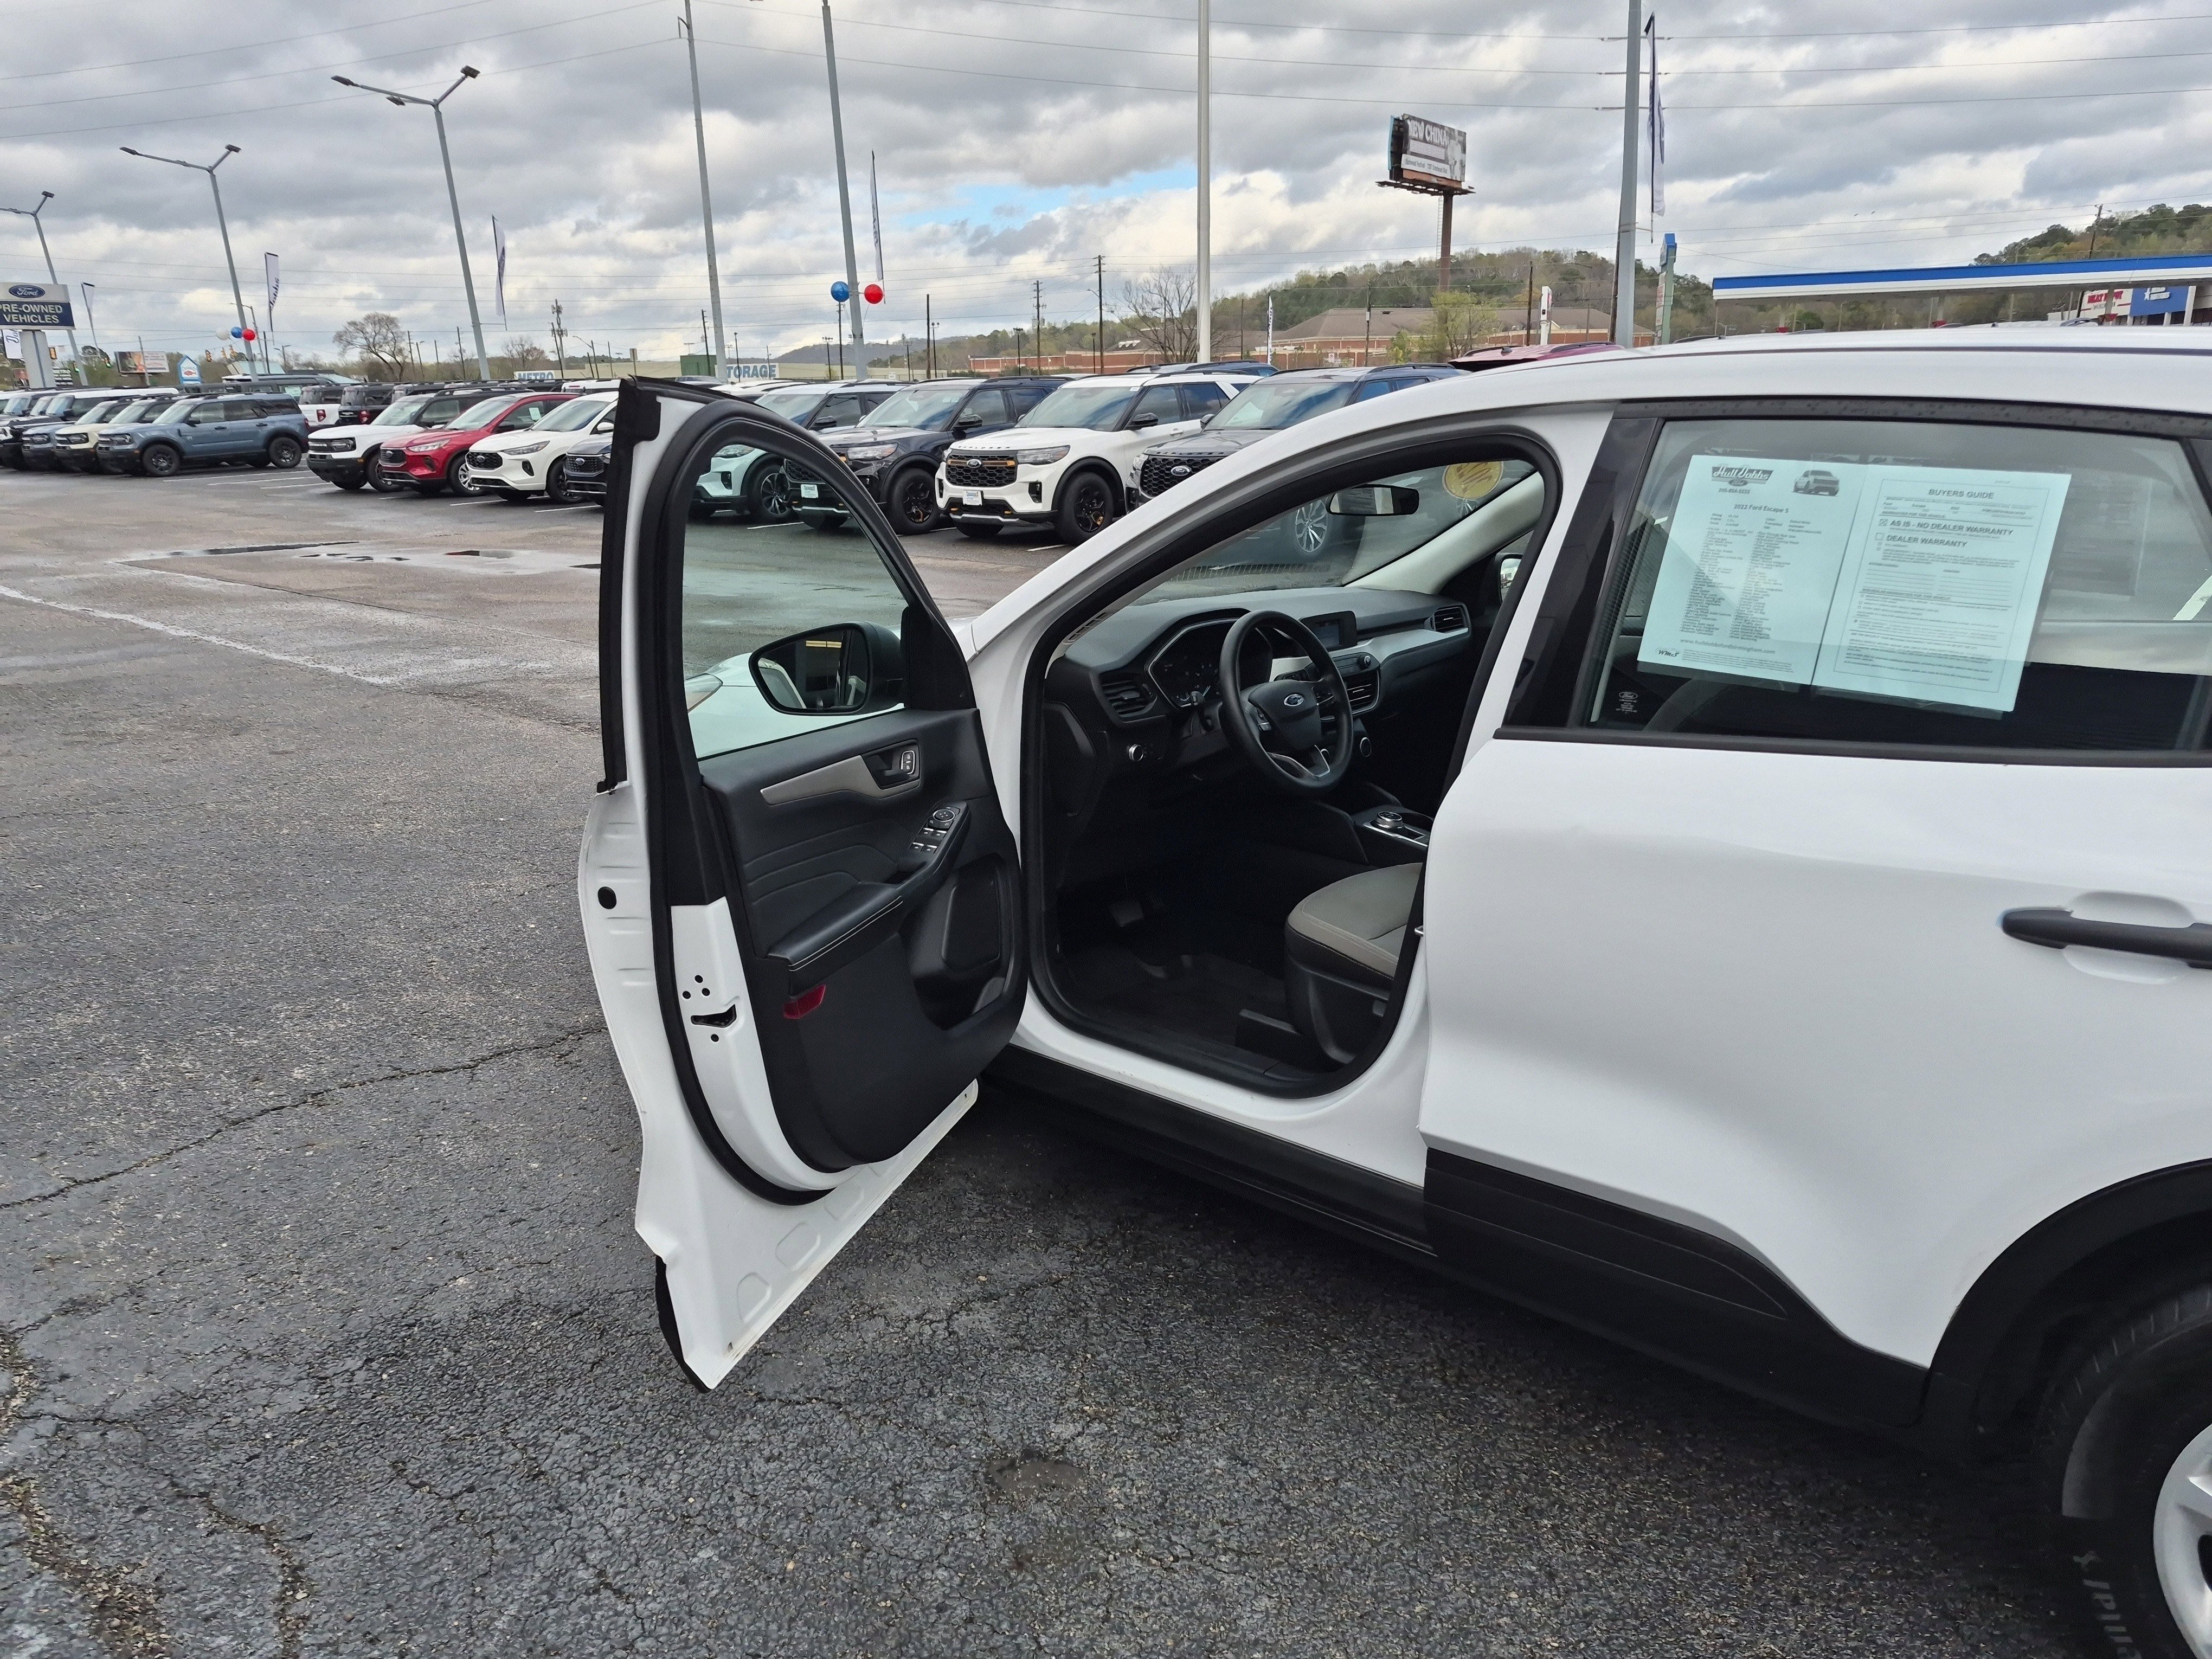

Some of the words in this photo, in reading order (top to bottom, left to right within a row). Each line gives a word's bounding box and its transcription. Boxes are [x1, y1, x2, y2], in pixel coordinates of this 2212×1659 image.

[1407, 119, 1425, 140] NEW
[1425, 124, 1449, 146] CHINA
[16, 287, 39, 296] Ford
[0, 304, 63, 314] RE-OWNED
[3, 314, 60, 324] VEHICLES
[727, 364, 776, 378] TORAGE
[1928, 488, 1965, 498] BUYERS
[1967, 491, 1995, 499] GUIDE
[1763, 505, 1784, 513] Escape
[1931, 523, 1965, 532] DEALER
[1965, 525, 2014, 536] WARRANTY
[1886, 535, 1920, 543] DEALER
[1920, 537, 1967, 548] WARRANTY
